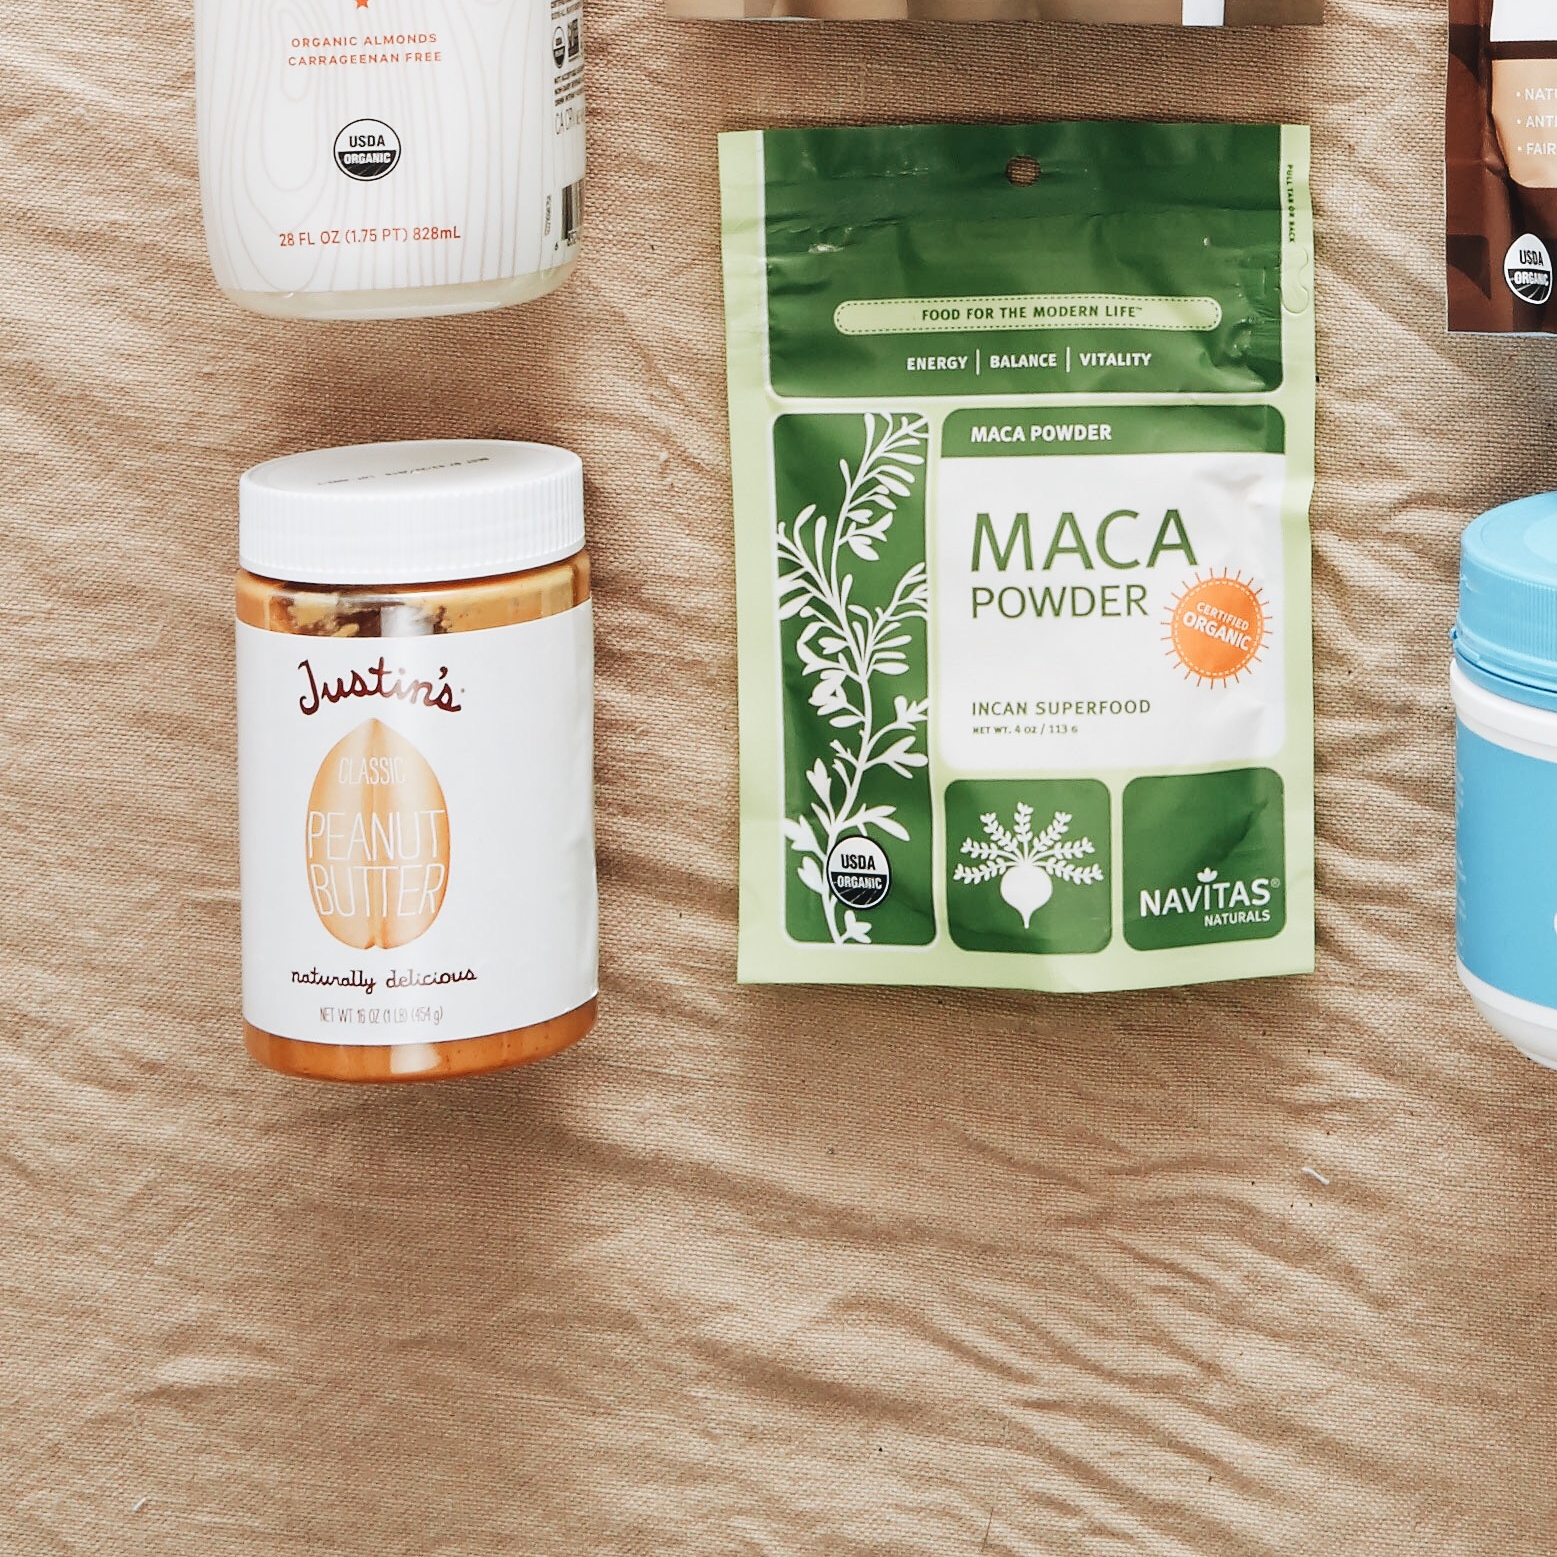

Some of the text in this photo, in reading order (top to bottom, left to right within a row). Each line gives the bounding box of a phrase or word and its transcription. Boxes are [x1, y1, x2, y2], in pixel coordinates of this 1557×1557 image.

[291, 33, 437, 48] ORGANIC ALMONDS
[288, 51, 442, 66] CARRAGEENAN FREE
[349, 135, 386, 148] USDA
[1526, 142, 1556, 156] FAIR
[343, 152, 391, 165] ORGANIC
[280, 225, 461, 247] 28 FL OZ (1.75 PT) 828mL
[1519, 249, 1544, 266] USDA
[922, 307, 962, 322] FOOD
[966, 306, 994, 320] FOR
[999, 306, 1027, 319] THE
[1033, 304, 1099, 319] MODERN
[906, 352, 1151, 371] ENERGY BALANCE VITALITY
[971, 424, 1112, 442] MACA POWDER
[971, 509, 1198, 572] MACA
[971, 584, 1149, 619] POWDER
[1196, 600, 1250, 631] CERTIFIED
[1182, 611, 1252, 651] ORGANIC
[298, 657, 462, 715] Justin's
[971, 700, 1151, 716] INCAN SUPERFOOD
[338, 757, 405, 785] CLASSIC
[307, 809, 445, 861] PEANUT
[841, 854, 876, 870] USDA
[310, 864, 445, 917] BUTTER
[836, 875, 882, 890] ORGANIC
[1204, 909, 1271, 927] NATURALS
[291, 967, 477, 994] naturally delicious
